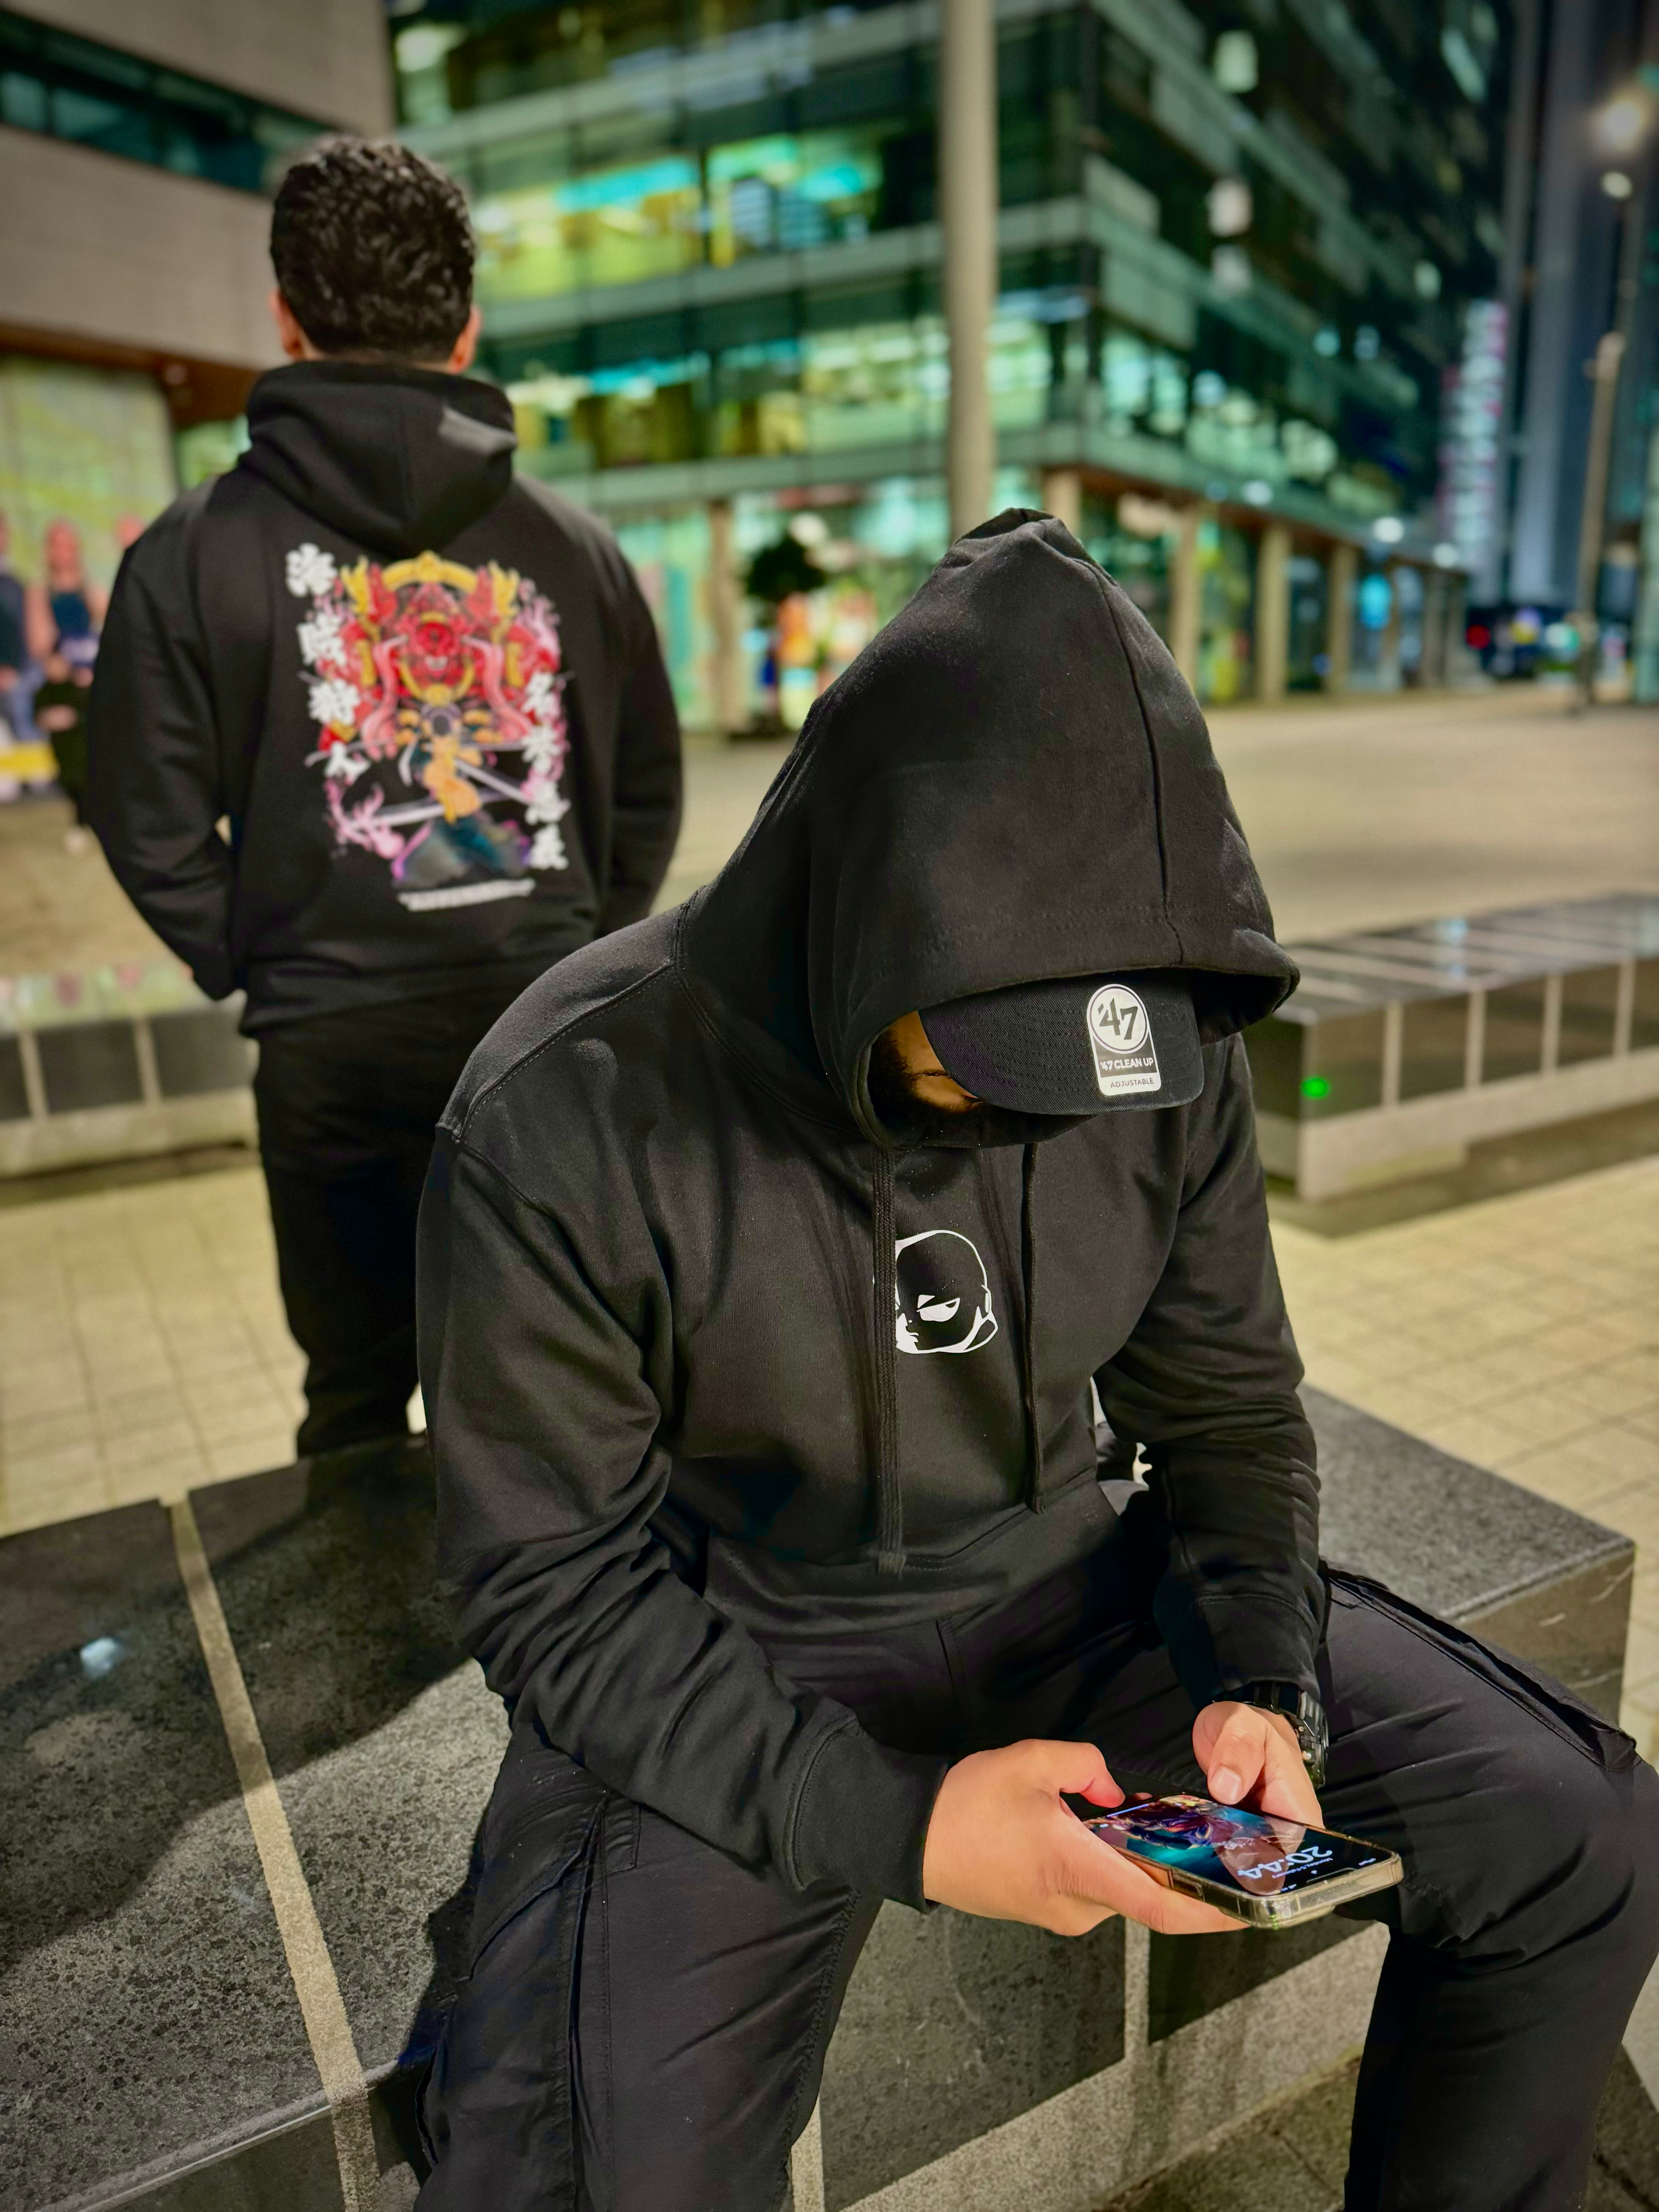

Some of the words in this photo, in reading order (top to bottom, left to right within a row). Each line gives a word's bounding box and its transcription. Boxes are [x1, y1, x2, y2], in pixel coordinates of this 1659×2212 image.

[1114, 1058, 1143, 1070] CLEAN
[1144, 1057, 1154, 1066] UP
[1110, 1078, 1154, 1088] ADJUSTABLE
[1238, 1846, 1333, 1879] 20:44
